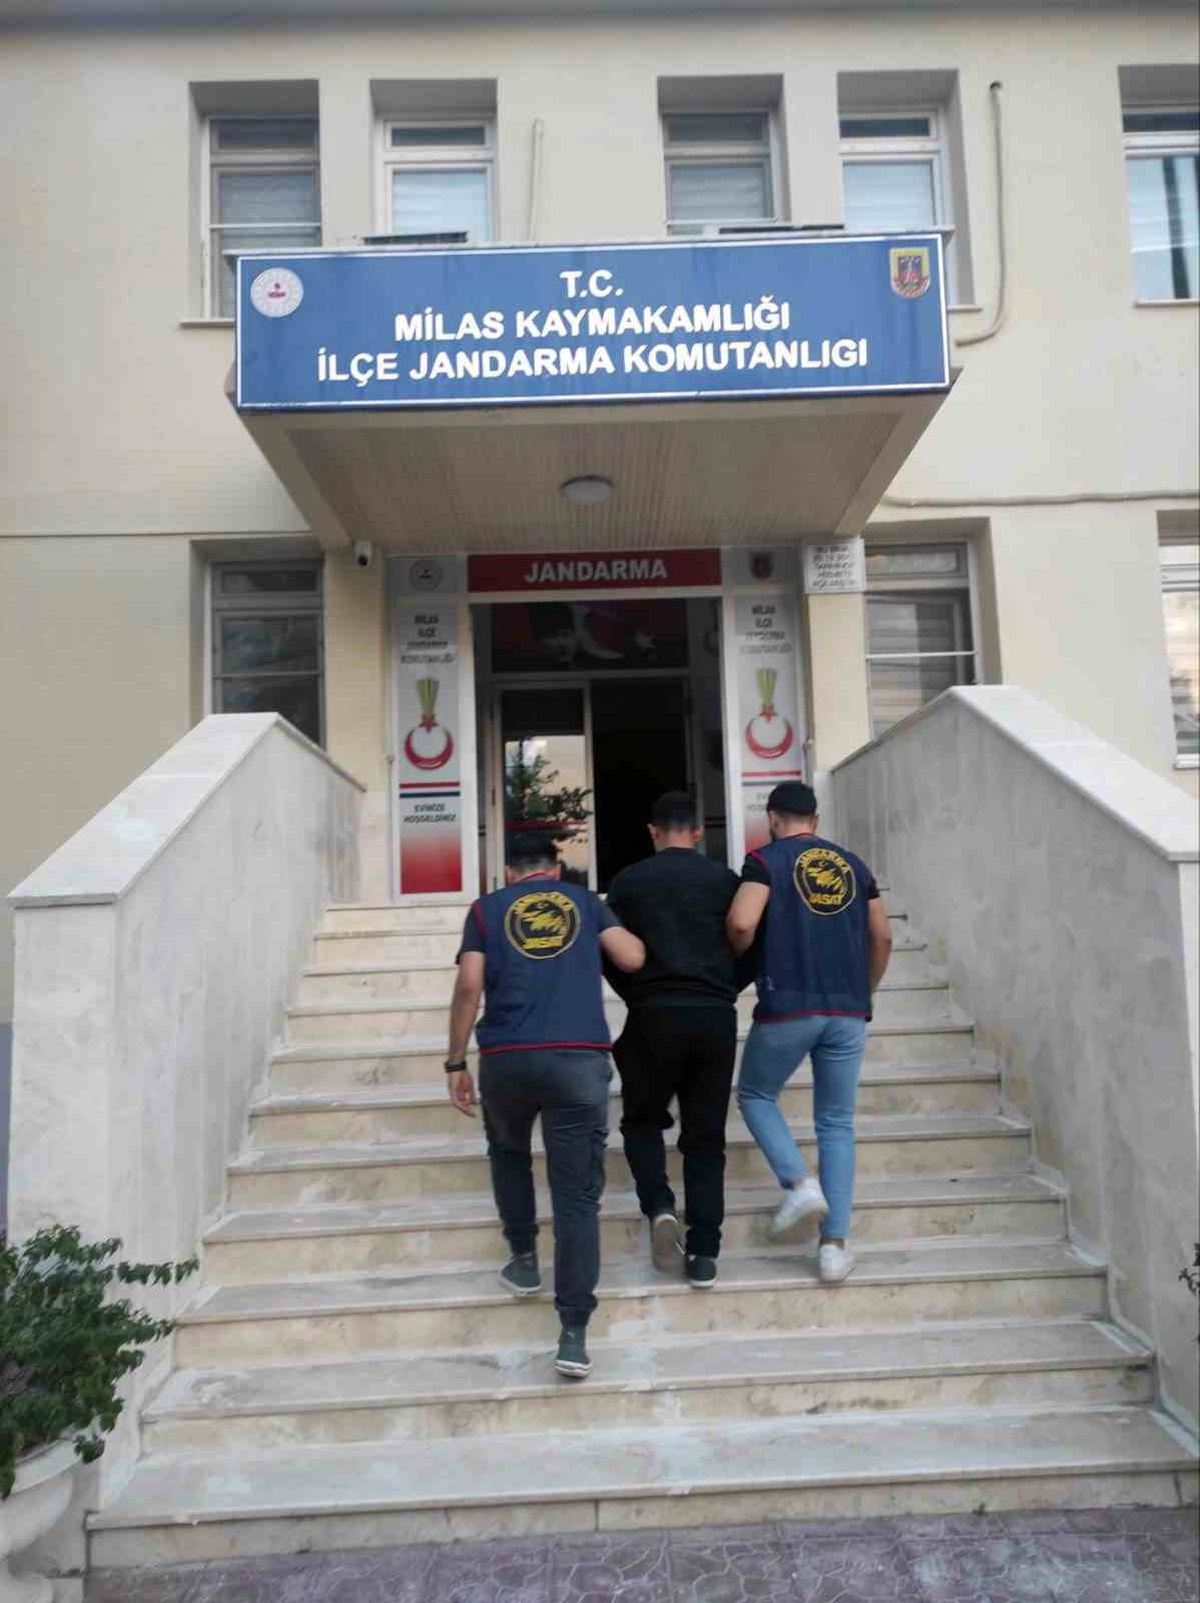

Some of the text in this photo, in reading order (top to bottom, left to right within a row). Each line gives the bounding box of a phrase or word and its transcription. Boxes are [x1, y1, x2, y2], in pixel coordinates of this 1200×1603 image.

[559, 269, 624, 299] T.C.
[394, 294, 790, 342] MİLAS KAYMAKAMLIĞI
[317, 338, 868, 387] İLÇE JANDARMA KOMUTANLIGI
[523, 558, 668, 583] JANDARMA
